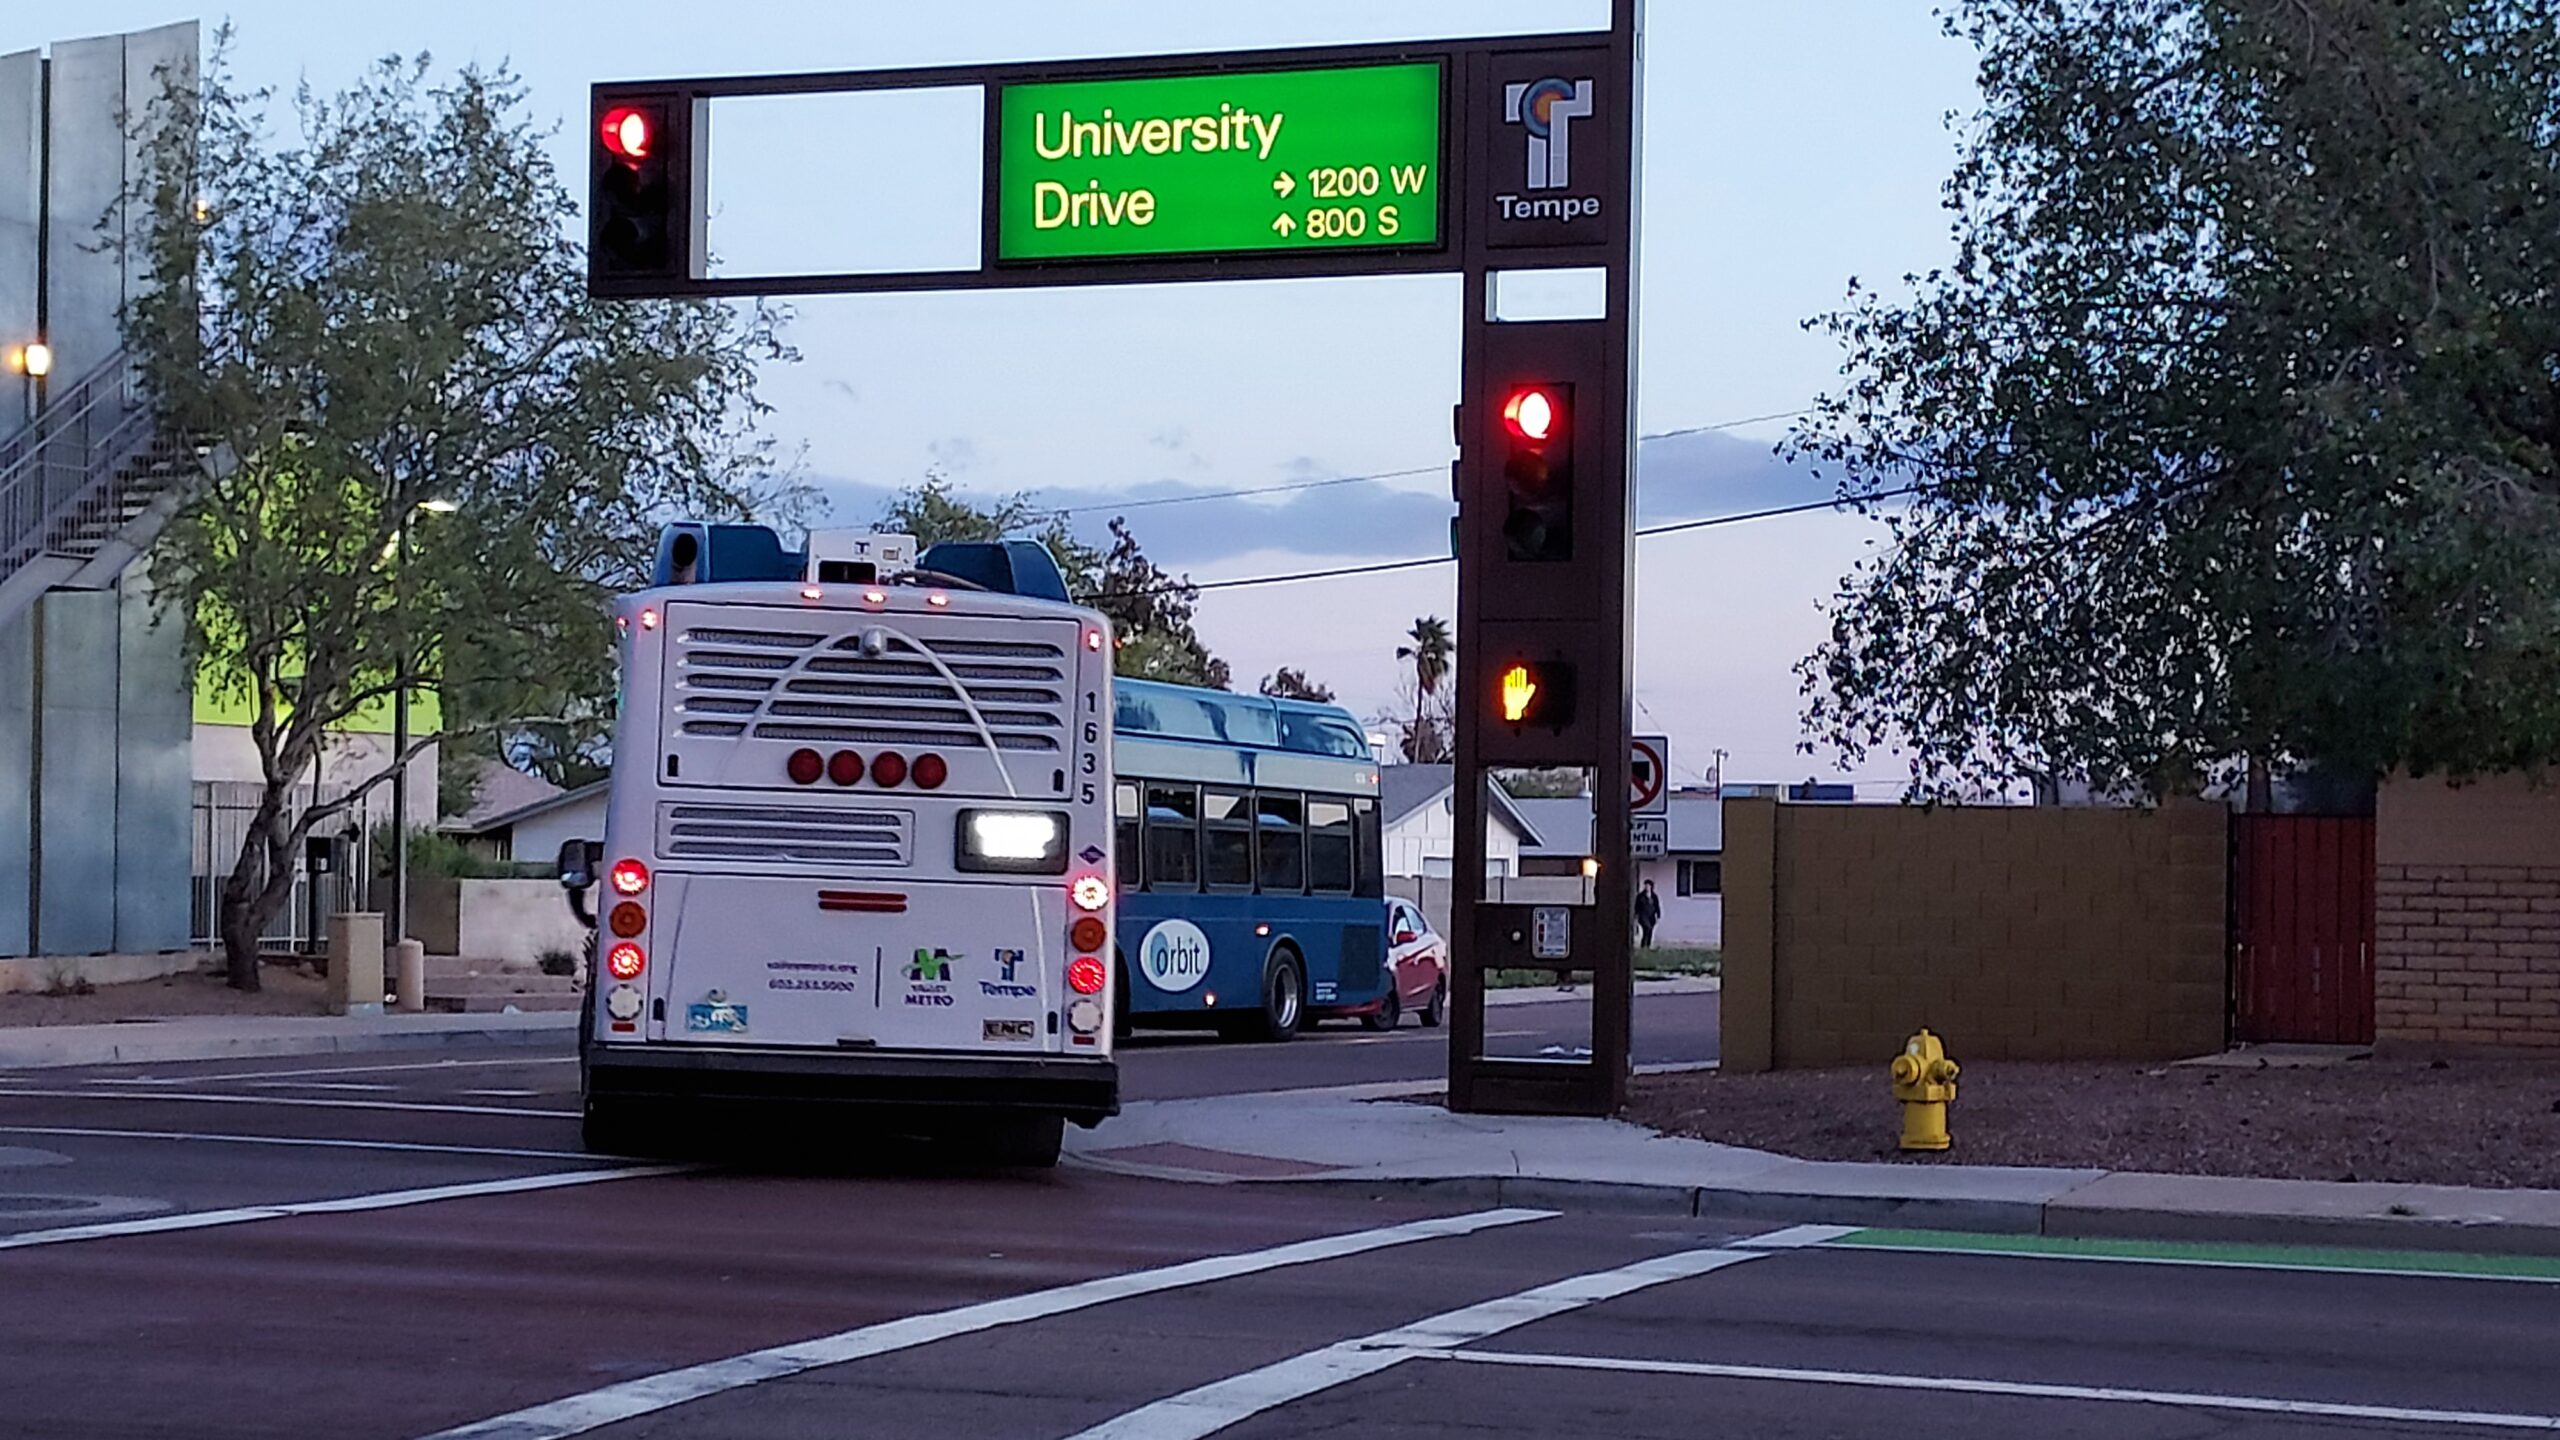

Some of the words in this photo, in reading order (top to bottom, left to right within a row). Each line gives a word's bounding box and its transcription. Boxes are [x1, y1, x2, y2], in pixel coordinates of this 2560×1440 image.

[1036, 103, 1283, 159] University
[1308, 166, 1379, 198] 1200
[1390, 165, 1427, 194] W
[1035, 180, 1155, 228] Drive
[1496, 195, 1600, 221] Tempe
[1306, 207, 1366, 238] 800
[1378, 206, 1399, 236] S
[1081, 692, 1098, 804] 1635
[1632, 833, 1663, 842] NTIAL
[1157, 936, 1203, 975] orbit
[904, 994, 954, 1006] METRO
[978, 981, 1037, 999] Tempe
